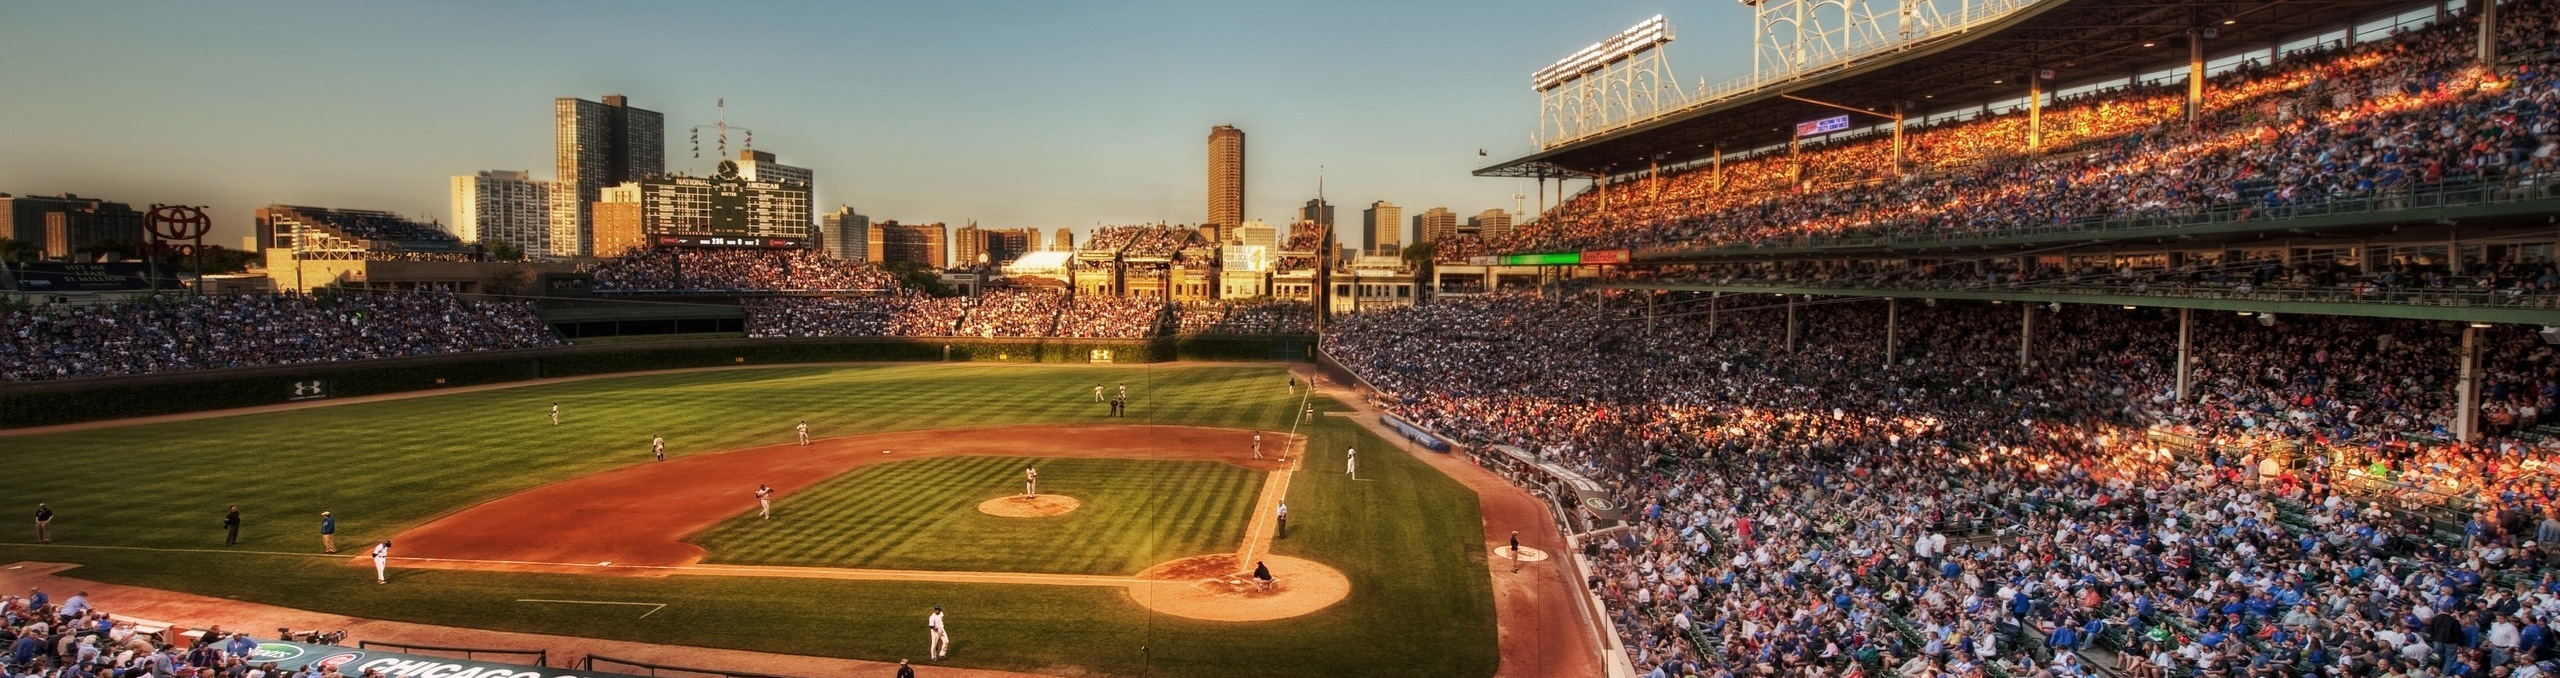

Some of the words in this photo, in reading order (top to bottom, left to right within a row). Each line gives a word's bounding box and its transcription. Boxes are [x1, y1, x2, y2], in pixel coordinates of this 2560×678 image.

[676, 178, 712, 186] NATIONAL
[746, 181, 780, 189] AMERICAN
[1582, 252, 1616, 262] AutoTrader
